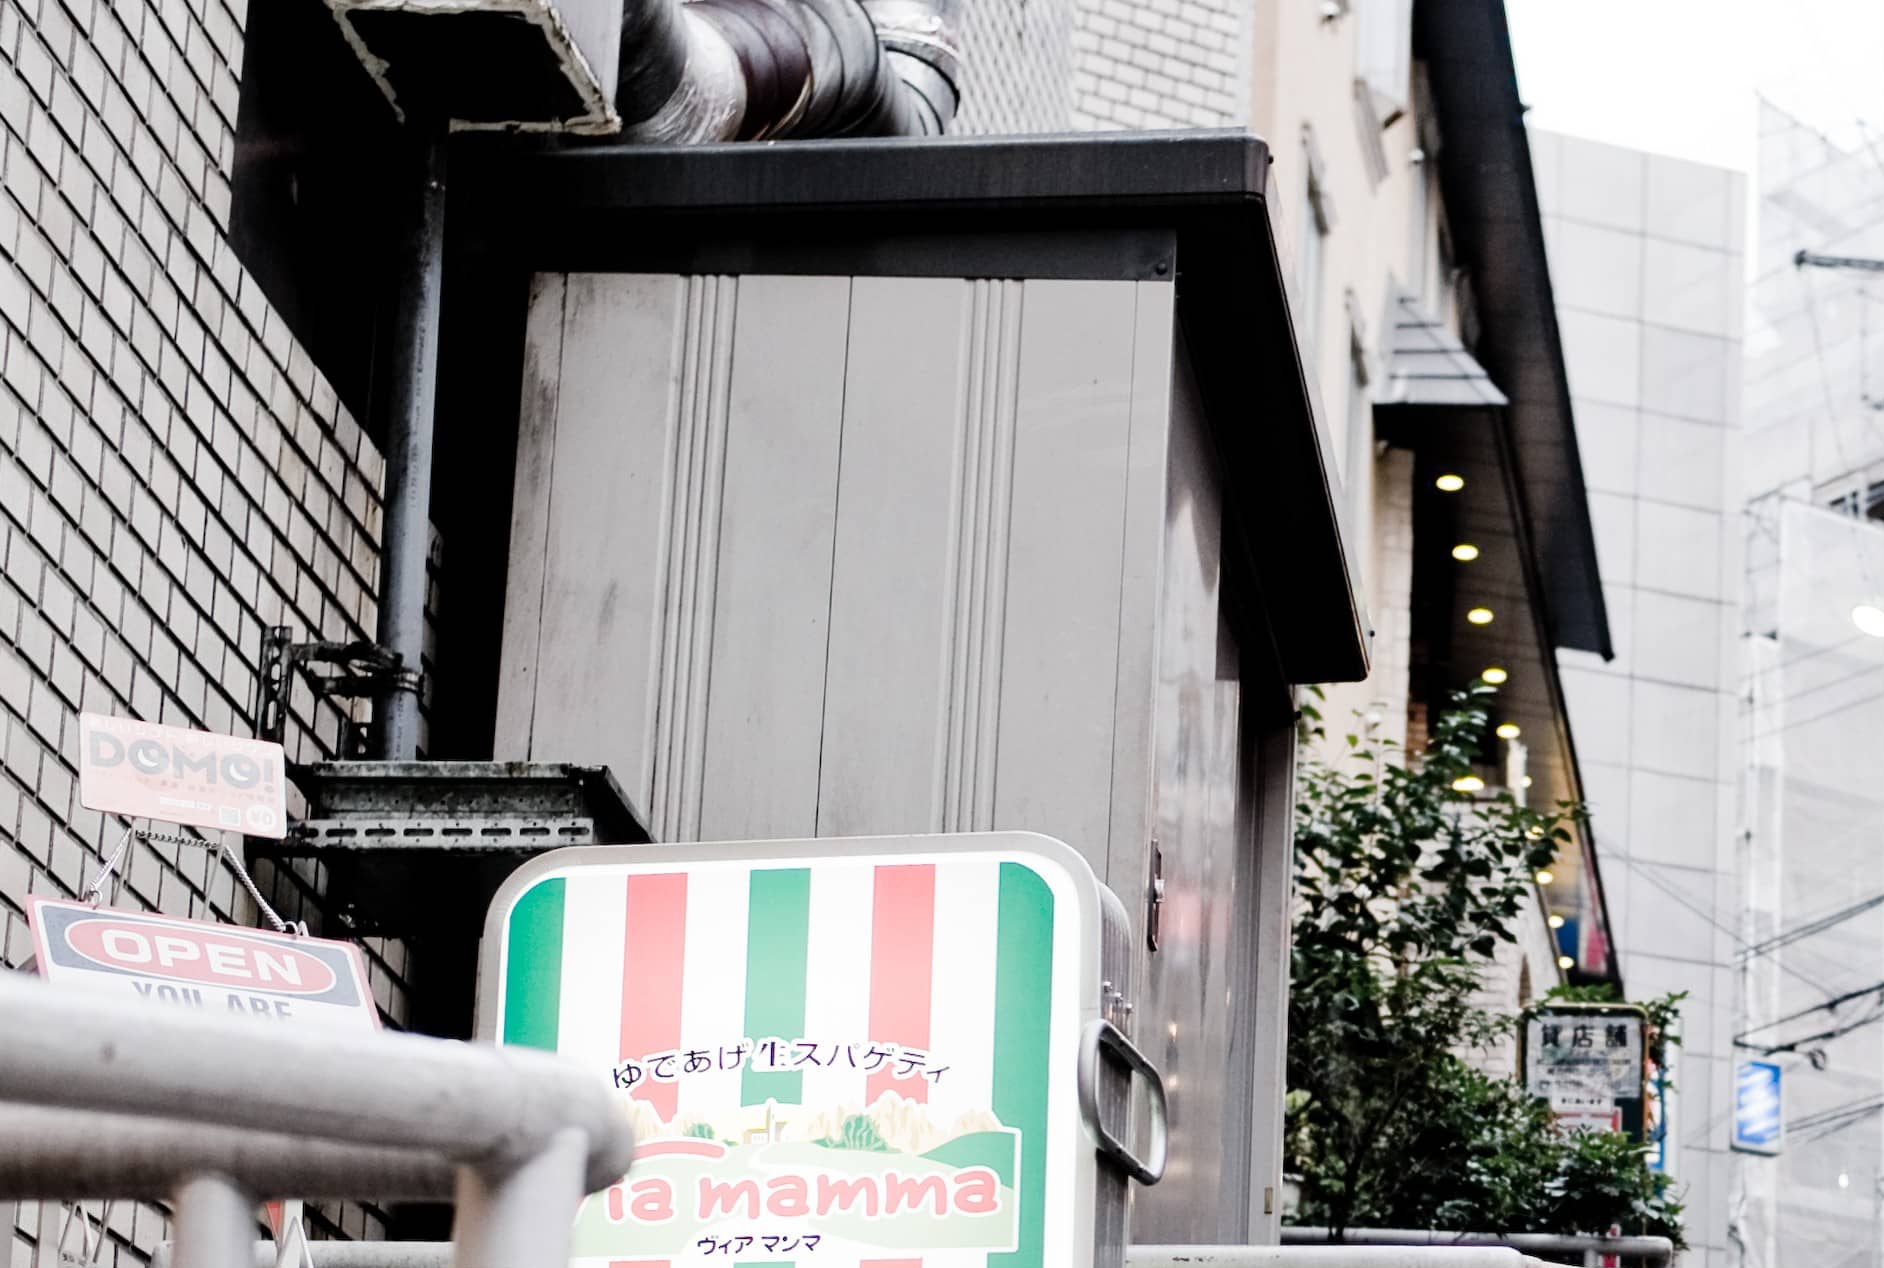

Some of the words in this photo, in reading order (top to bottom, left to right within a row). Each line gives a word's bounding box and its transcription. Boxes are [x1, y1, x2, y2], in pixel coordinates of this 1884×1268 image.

[89, 730, 275, 793] DOMO!
[101, 929, 303, 986] OPEN
[608, 1177, 674, 1221] ia
[698, 1170, 999, 1218] mamma
[696, 1234, 753, 1255] ヴィア
[762, 1233, 821, 1254] マンマ
